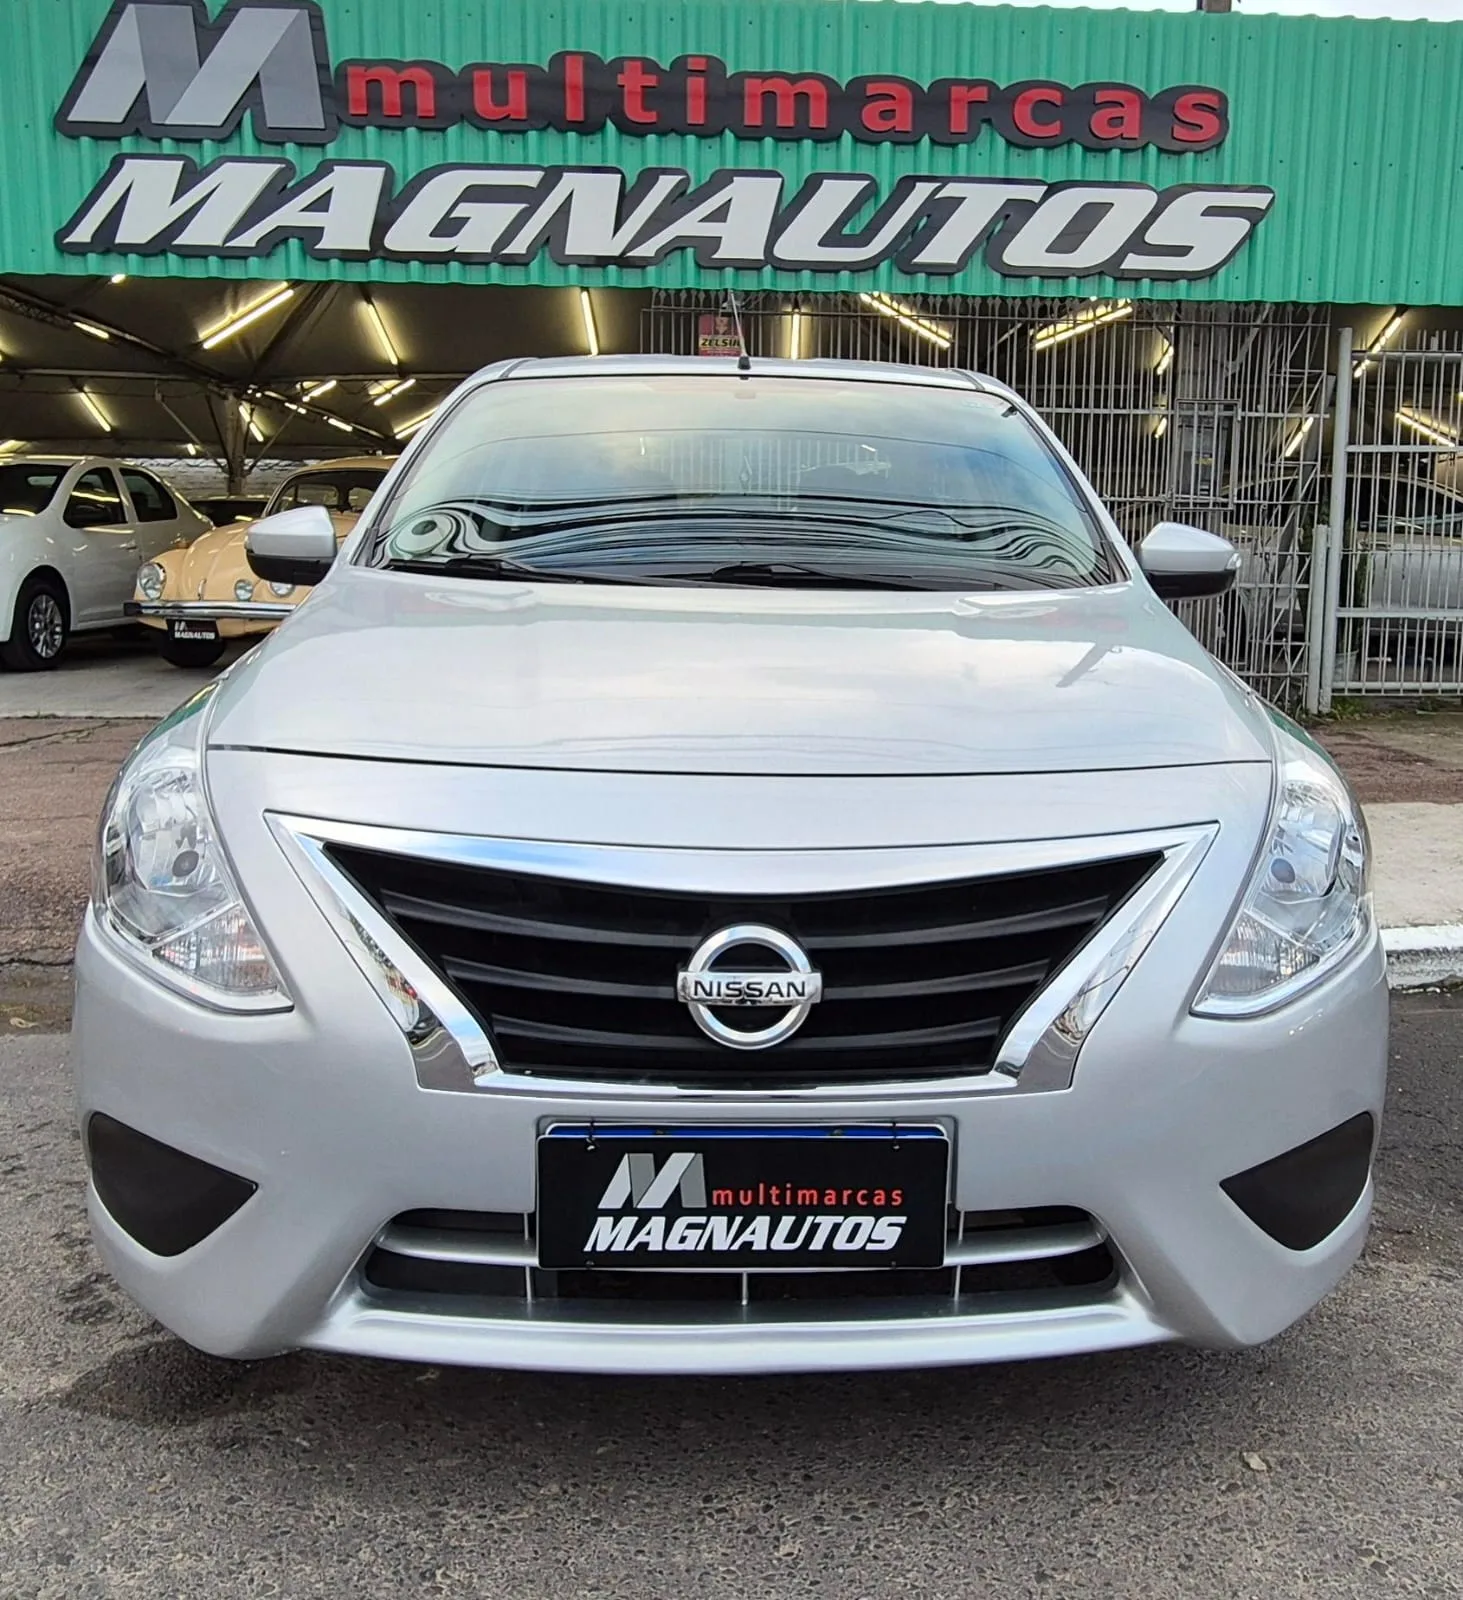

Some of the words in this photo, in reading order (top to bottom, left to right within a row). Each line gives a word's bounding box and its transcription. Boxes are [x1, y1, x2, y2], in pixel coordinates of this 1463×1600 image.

[346, 54, 1223, 143] multimarcas
[62, 158, 1275, 272] MAGNAUTOS
[174, 631, 216, 640] MAGNAUTOS
[693, 980, 806, 998] NISSAN
[711, 1183, 903, 1206] multimarcas
[583, 1215, 908, 1252] MAGNAUTOS
